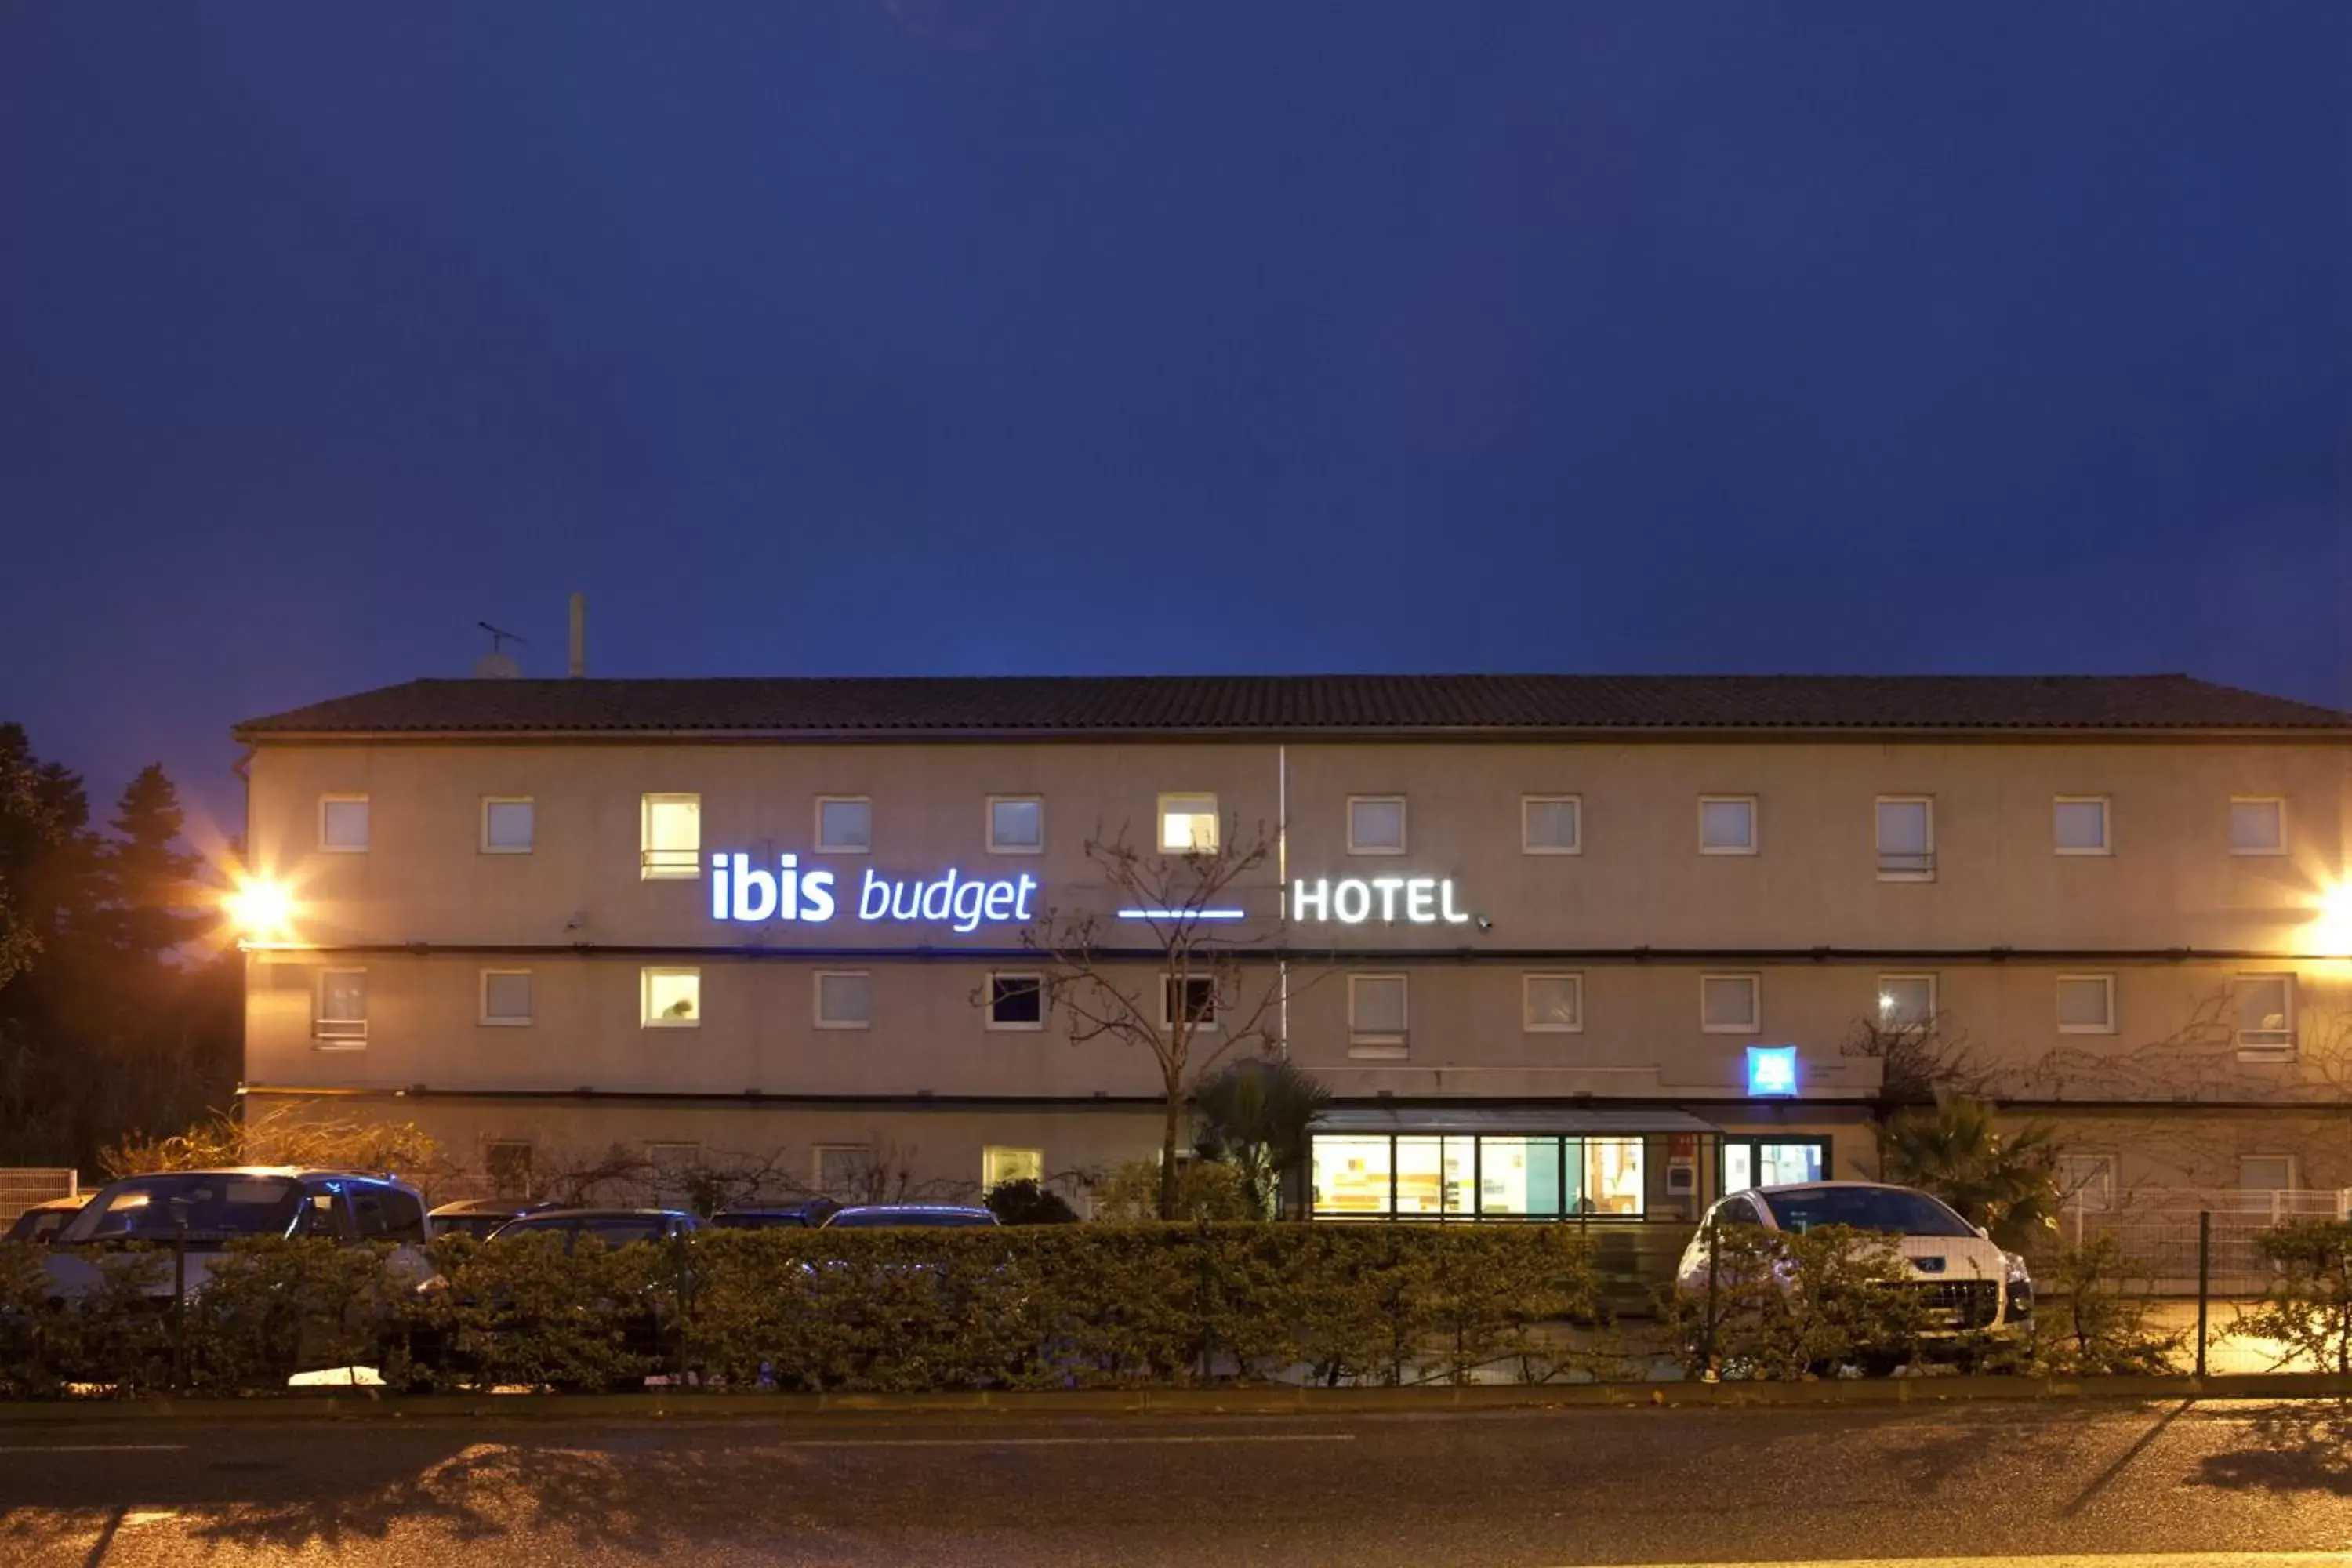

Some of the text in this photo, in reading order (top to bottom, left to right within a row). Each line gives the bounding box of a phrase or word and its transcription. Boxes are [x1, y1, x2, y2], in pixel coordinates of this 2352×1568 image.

[712, 852, 1036, 932] ibis budget
[1293, 877, 1469, 924] HOTEL
